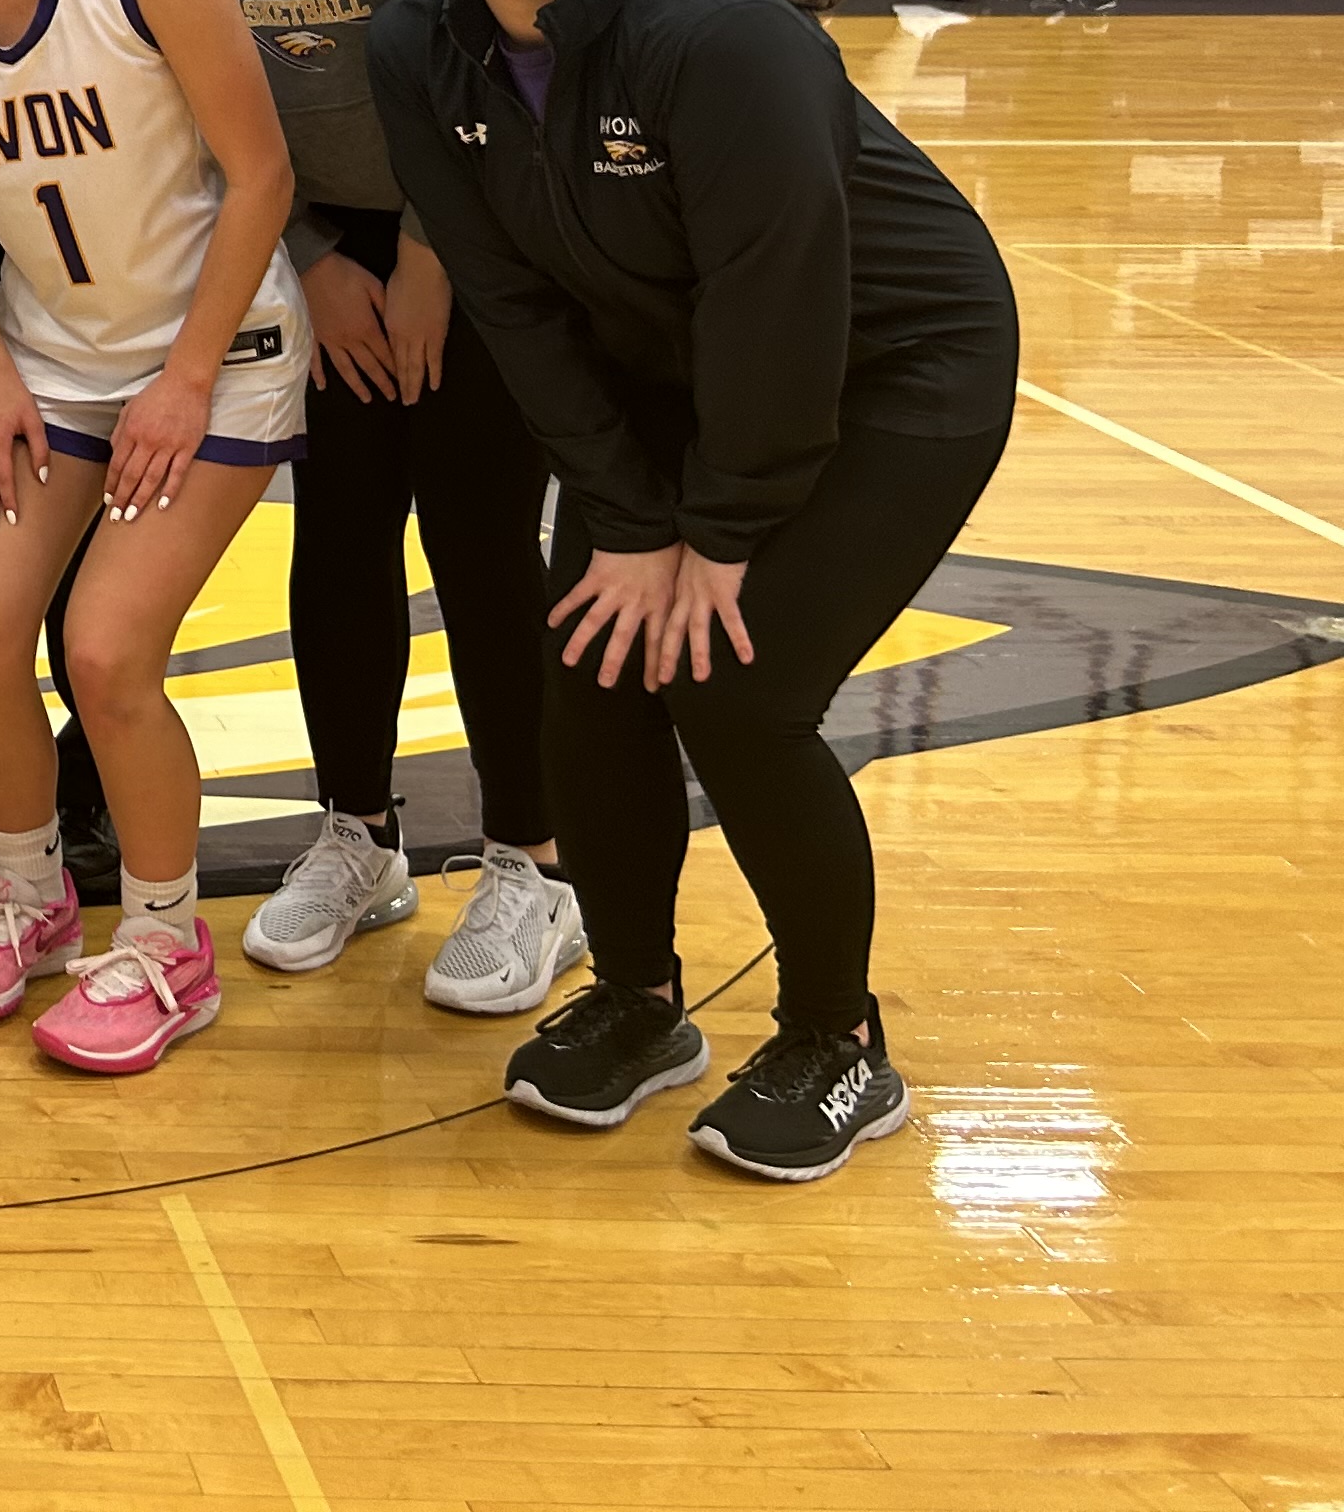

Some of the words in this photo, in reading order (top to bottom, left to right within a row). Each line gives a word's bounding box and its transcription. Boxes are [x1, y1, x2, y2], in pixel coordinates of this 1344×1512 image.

[33, 182, 96, 286] 1
[263, 336, 275, 351] M
[818, 1058, 873, 1132] HOKA
